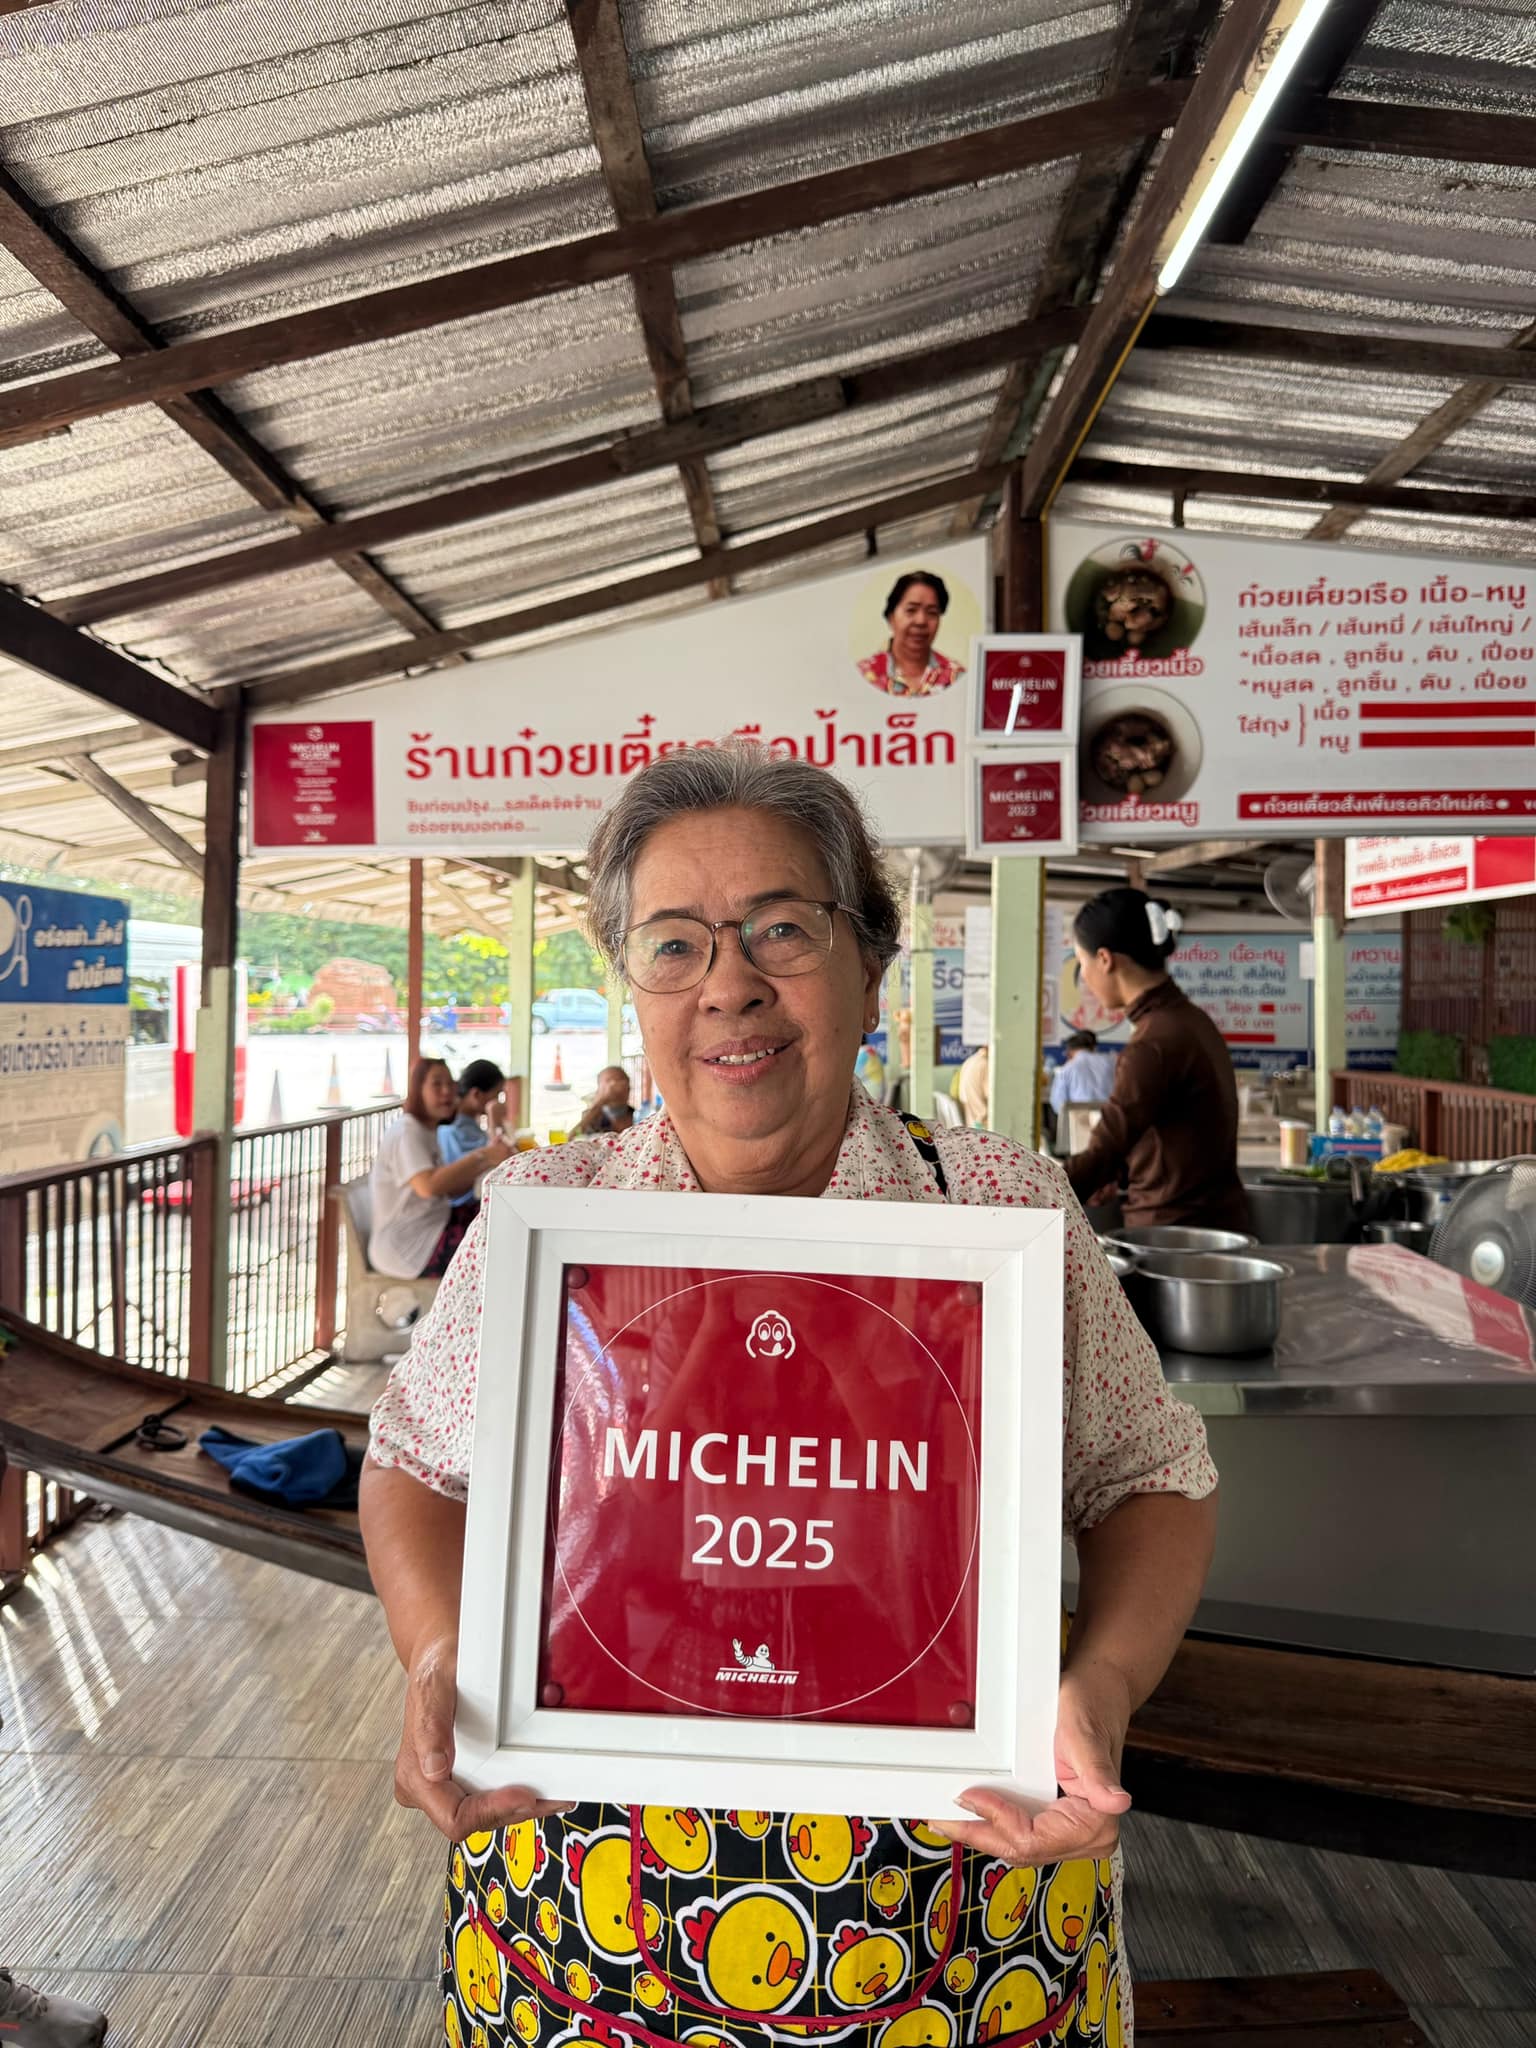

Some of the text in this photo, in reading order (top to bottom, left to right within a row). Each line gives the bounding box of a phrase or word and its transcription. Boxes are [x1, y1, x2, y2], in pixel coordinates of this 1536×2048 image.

[1239, 575, 1527, 609] ก๋วยเตี๋ยวเรือ เนื้อ-หมู
[1239, 616, 1312, 638] เส้นเล็ก
[1337, 612, 1405, 636] เส้นหมี่
[1429, 613, 1514, 636] เส้นใหญ่
[1344, 641, 1403, 669] ลูกชิ้น
[1427, 645, 1458, 663] ตับ
[1481, 639, 1534, 662] เปื่อย
[992, 678, 1057, 691] MICHELIN
[1337, 670, 1397, 698] ลูกชิ้น
[1420, 673, 1451, 692] ตับ
[1474, 668, 1527, 691] เปื่อย
[1314, 699, 1350, 721] เนื้อ
[1237, 714, 1290, 736] ใส่ถุง
[1320, 733, 1350, 754] หมู
[990, 789, 1054, 803] MICHELIN
[604, 1427, 929, 1492] MICHELIN
[691, 1513, 835, 1570] 2025
[715, 1671, 797, 1685] MICHELIN
